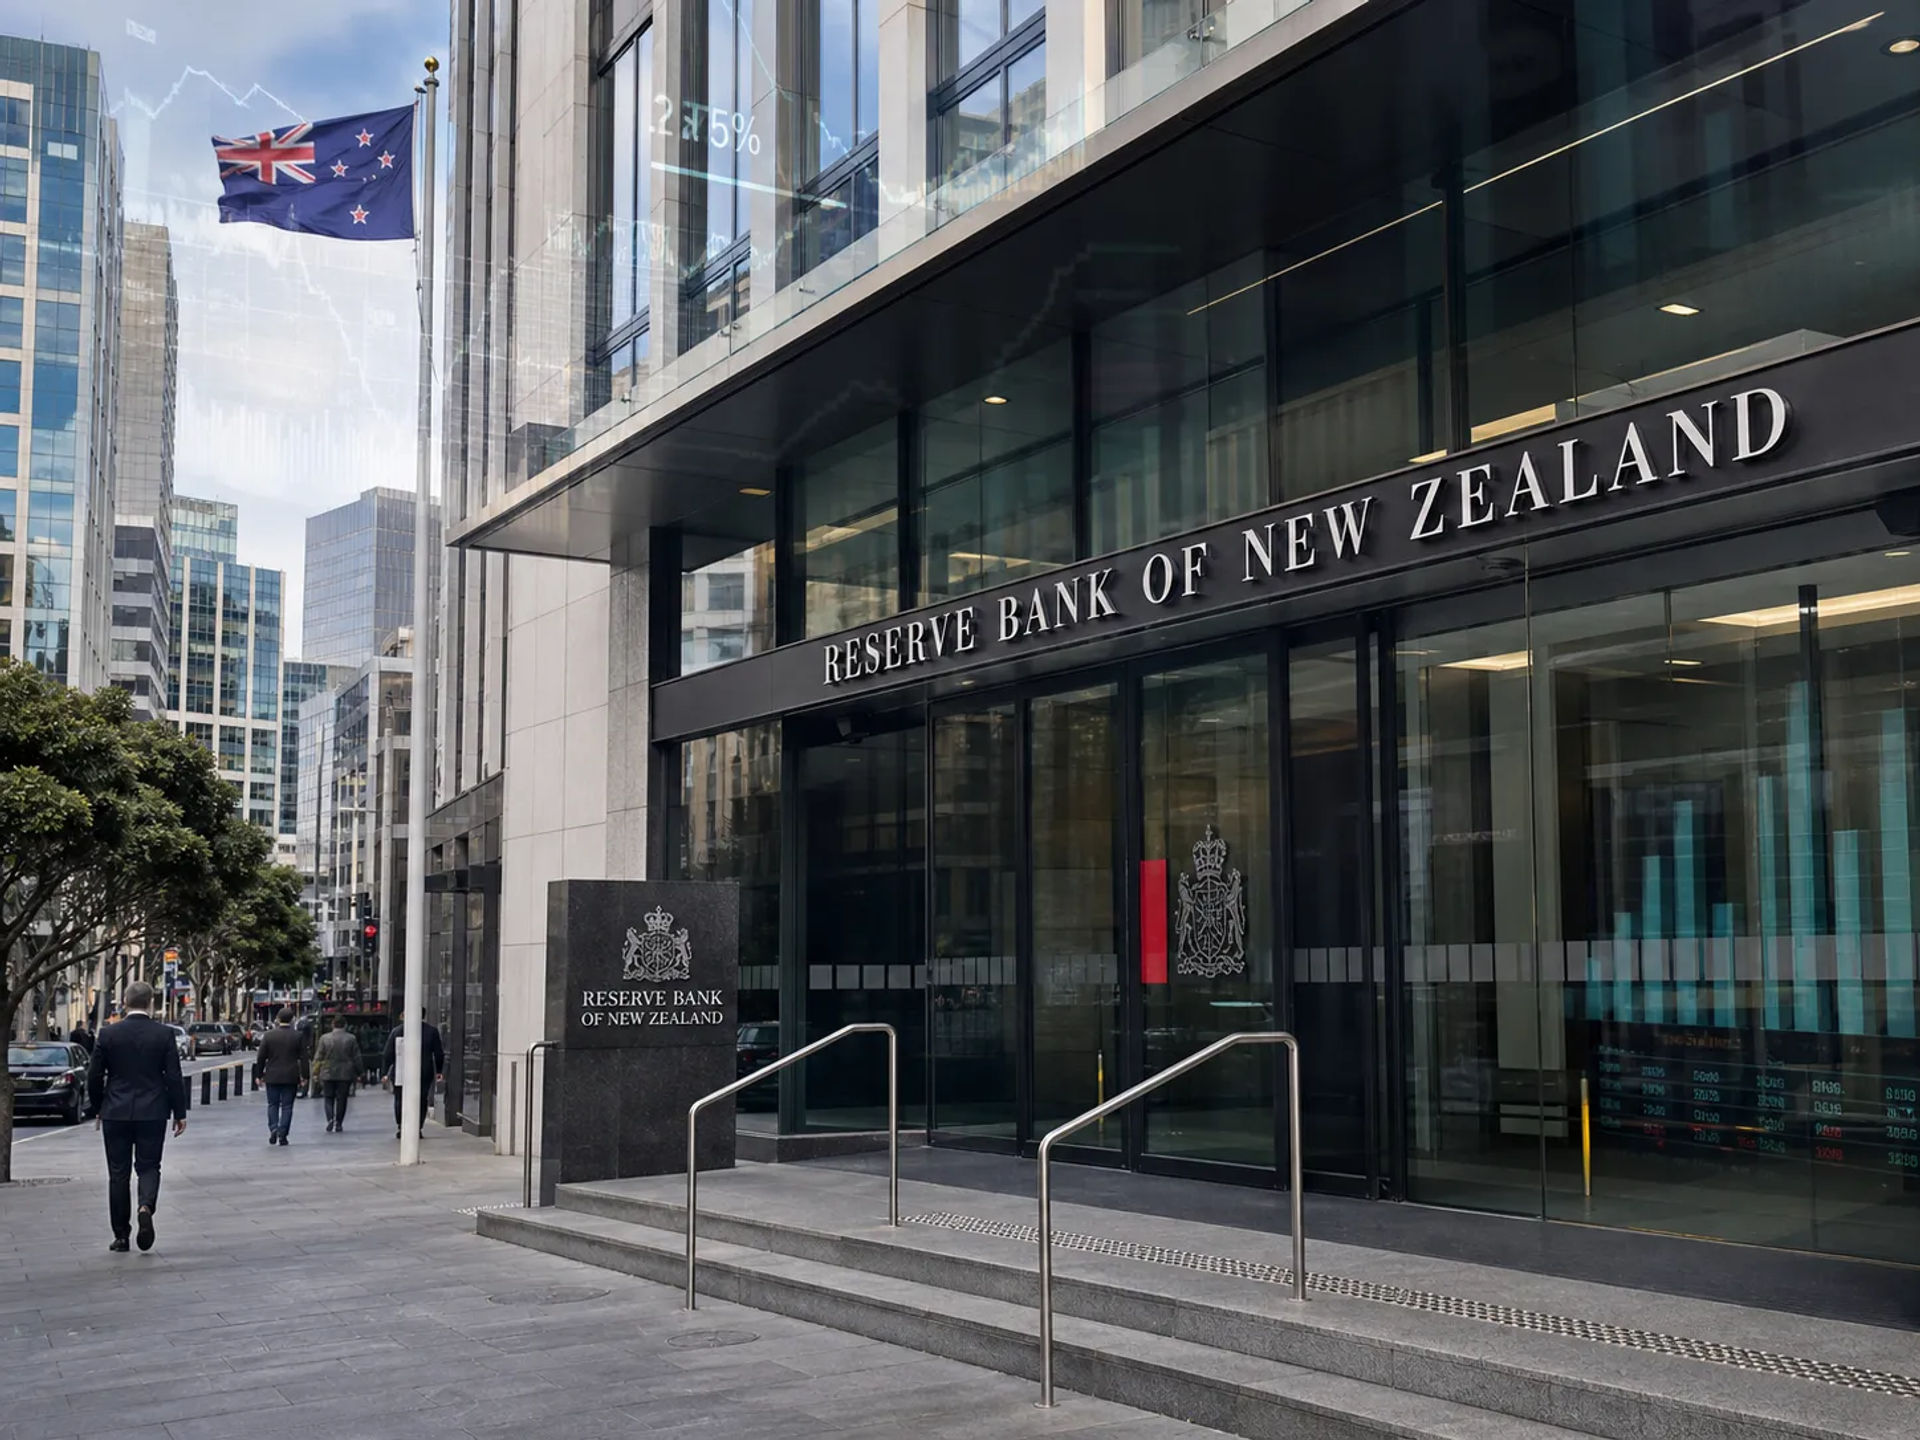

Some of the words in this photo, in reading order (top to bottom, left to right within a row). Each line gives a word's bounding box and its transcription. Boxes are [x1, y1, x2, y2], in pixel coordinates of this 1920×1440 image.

[823, 606, 976, 686] RESERVE
[997, 567, 1118, 642] BANK
[1142, 542, 1208, 604] OF
[1241, 496, 1374, 583] NEW
[1409, 387, 1788, 541] ZEALAND
[582, 990, 667, 1007] RESERVE
[673, 990, 723, 1006] BANK
[581, 1011, 604, 1027] OF
[607, 1011, 645, 1026] NEW
[648, 1011, 724, 1025] ZEALAND
